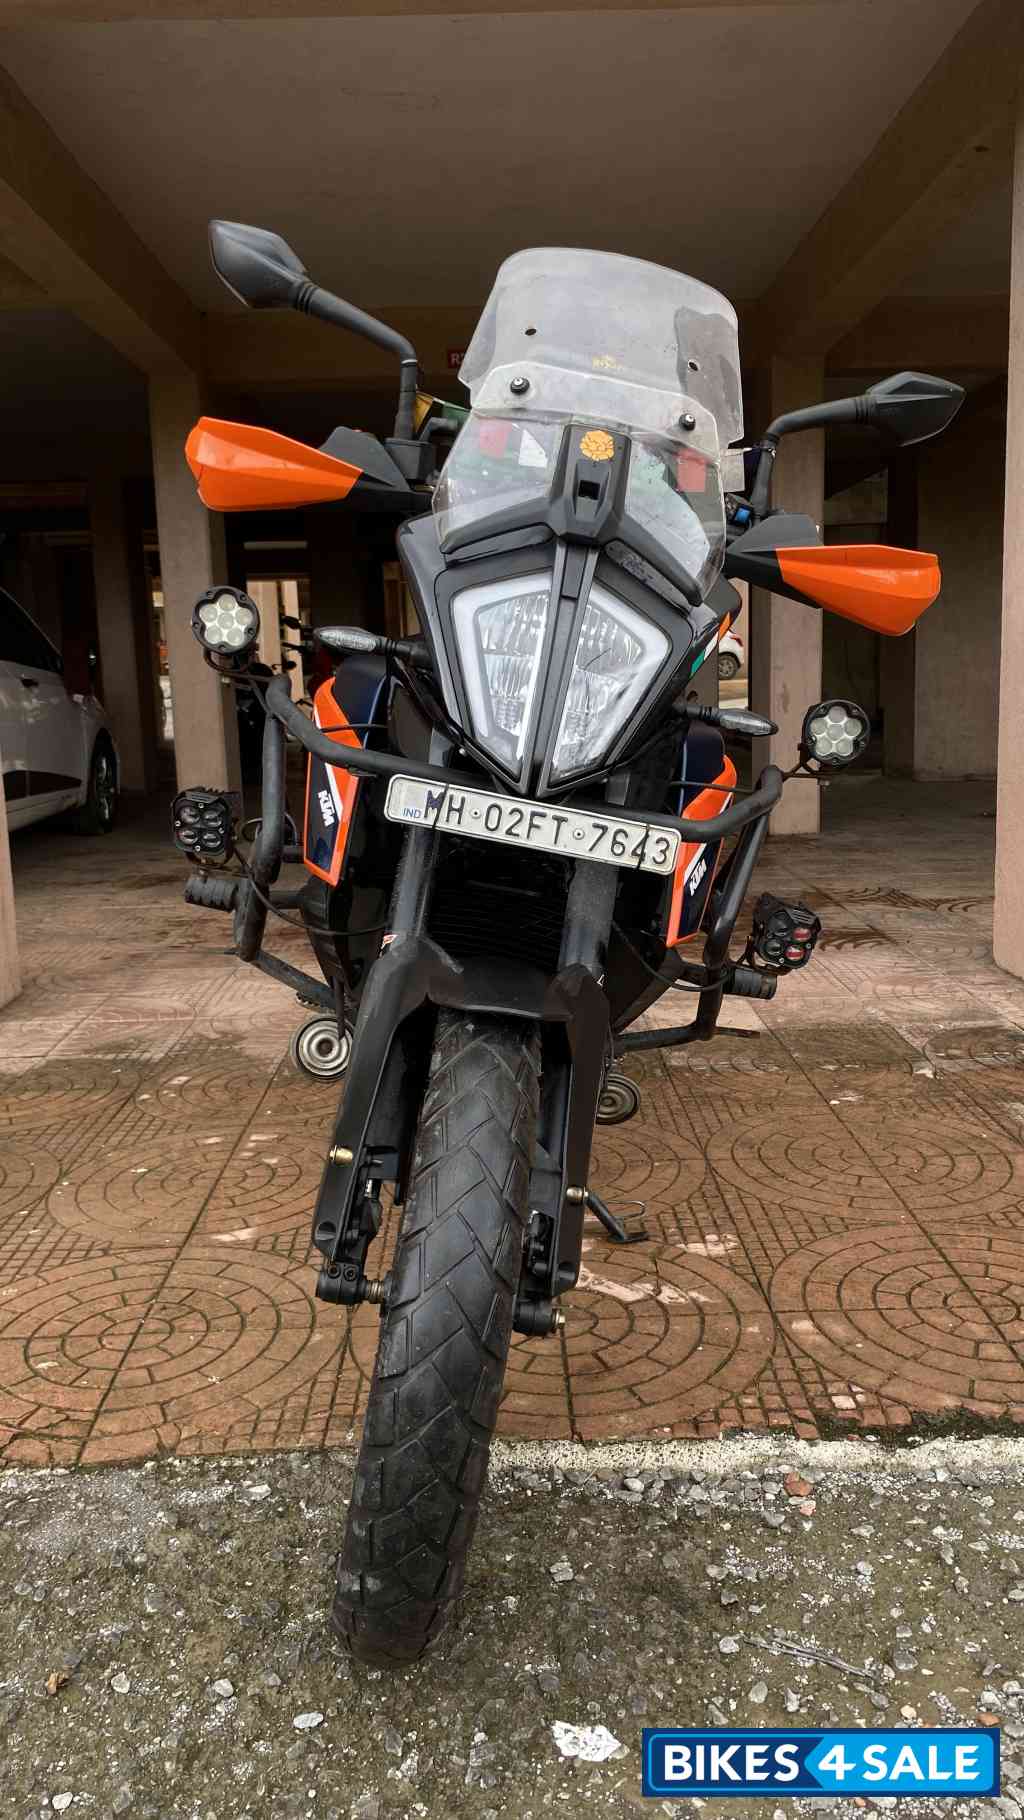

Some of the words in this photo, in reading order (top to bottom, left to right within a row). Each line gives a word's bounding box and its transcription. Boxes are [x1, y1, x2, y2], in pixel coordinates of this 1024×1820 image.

[317, 790, 335, 827] KTM
[402, 808, 422, 819] IND
[424, 790, 466, 825] MH
[485, 803, 569, 845] 02FT
[588, 823, 670, 865] 7643
[689, 858, 707, 896] KTM
